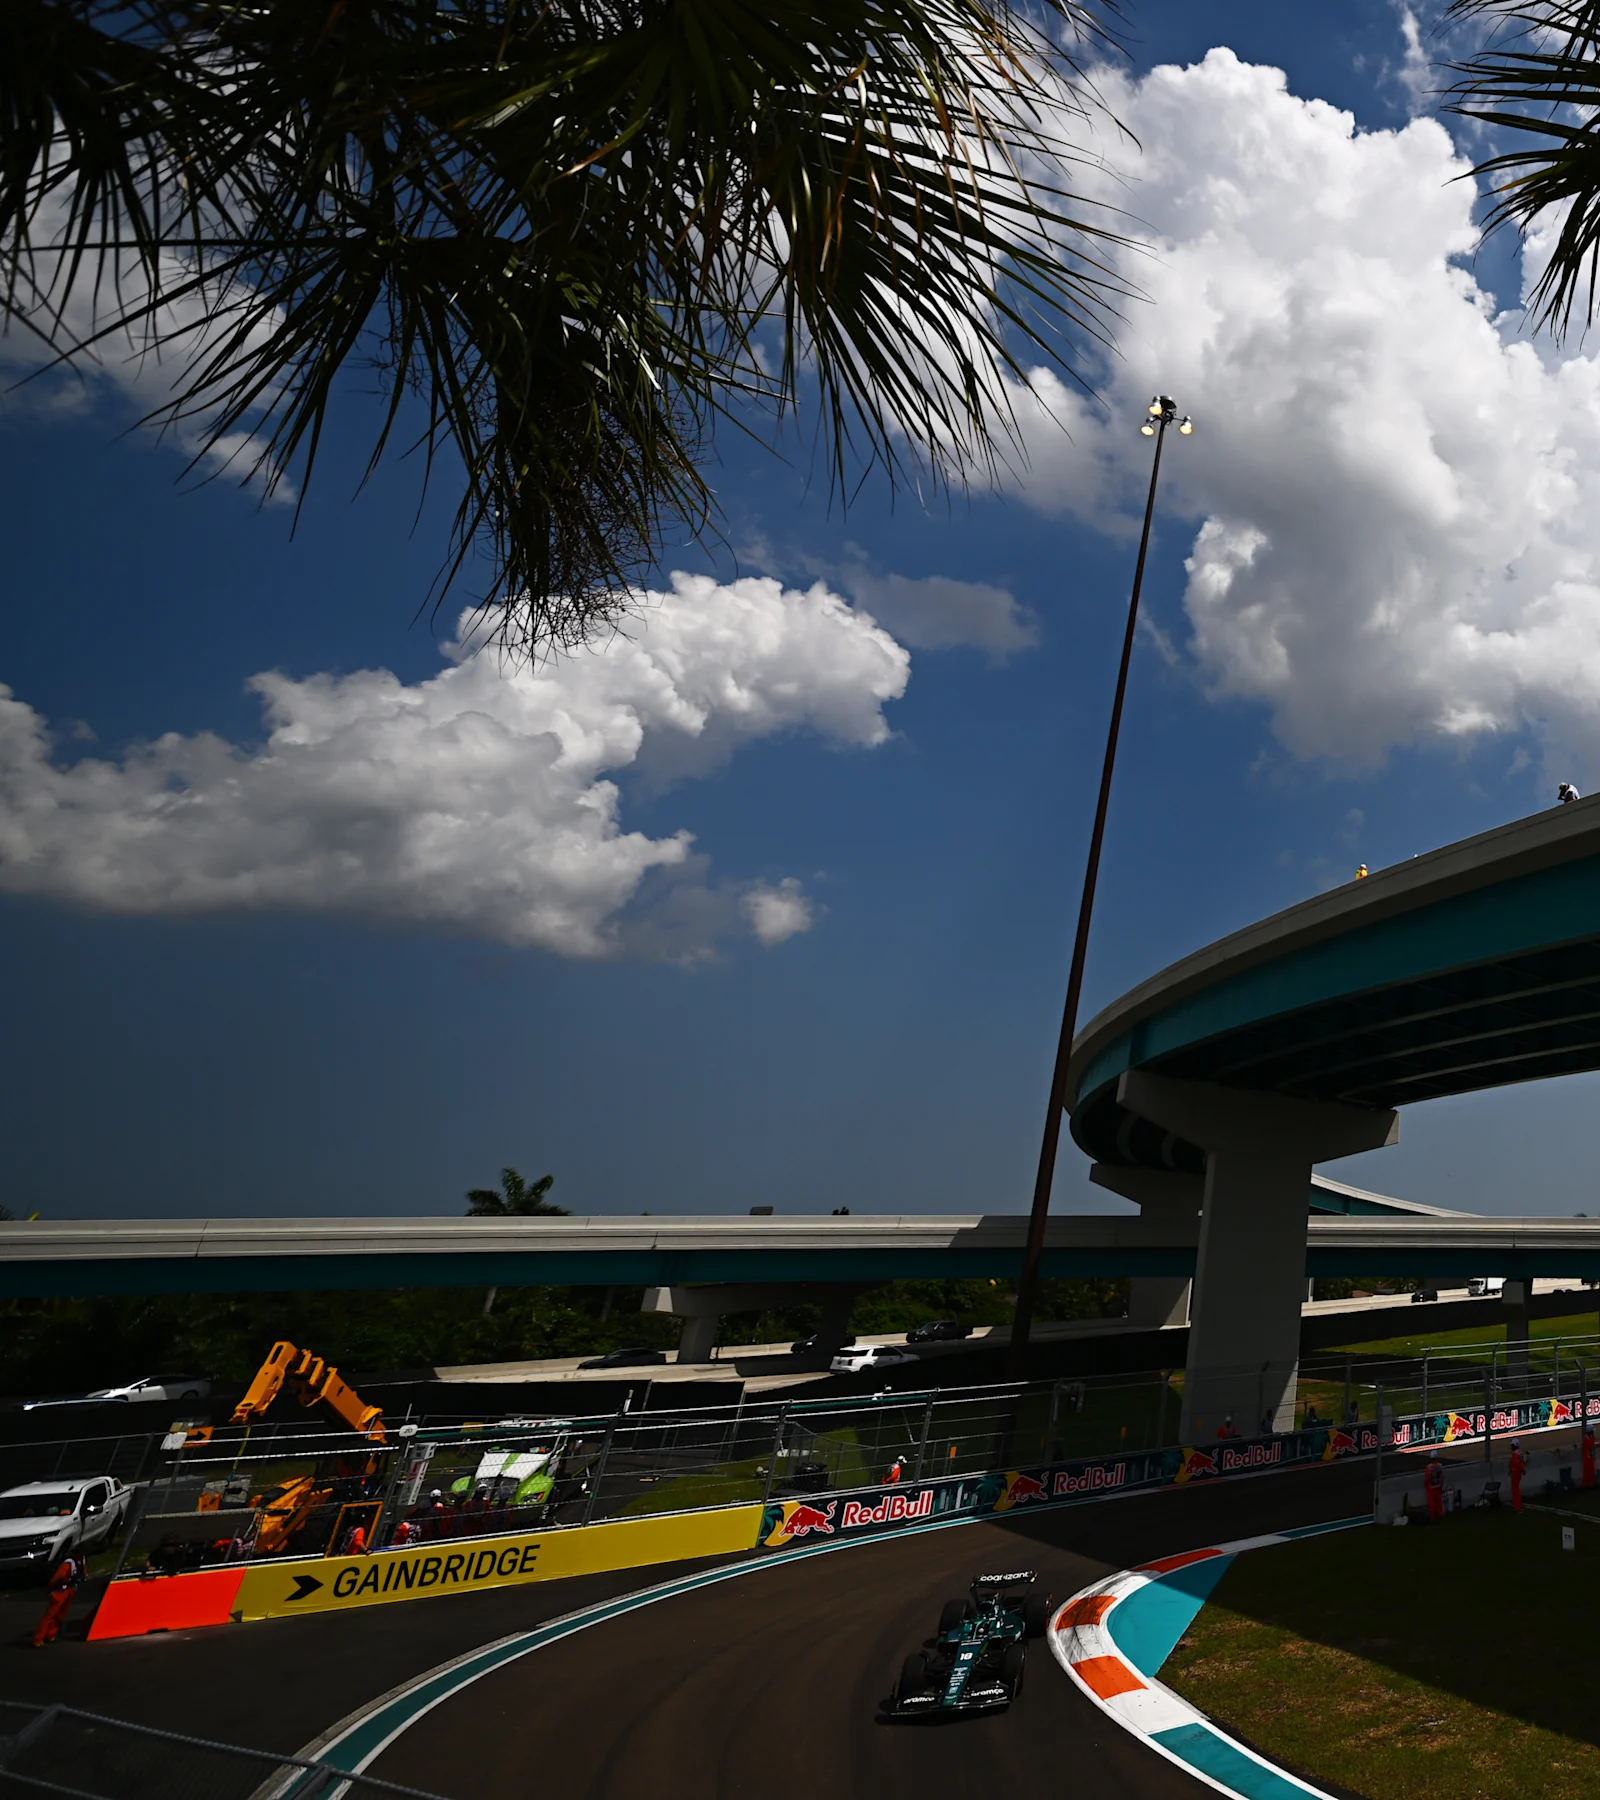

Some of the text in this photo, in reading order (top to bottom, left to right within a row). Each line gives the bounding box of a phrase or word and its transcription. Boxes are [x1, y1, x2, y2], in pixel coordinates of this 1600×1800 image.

[1477, 1409, 1518, 1432] Rd Bull
[1575, 1398, 1594, 1418] Rd
[1223, 1441, 1281, 1470] Red Bull
[1053, 1463, 1126, 1496] Red Bull
[841, 1490, 934, 1528] Red Bull
[333, 1545, 541, 1598] GAINBRIDGE
